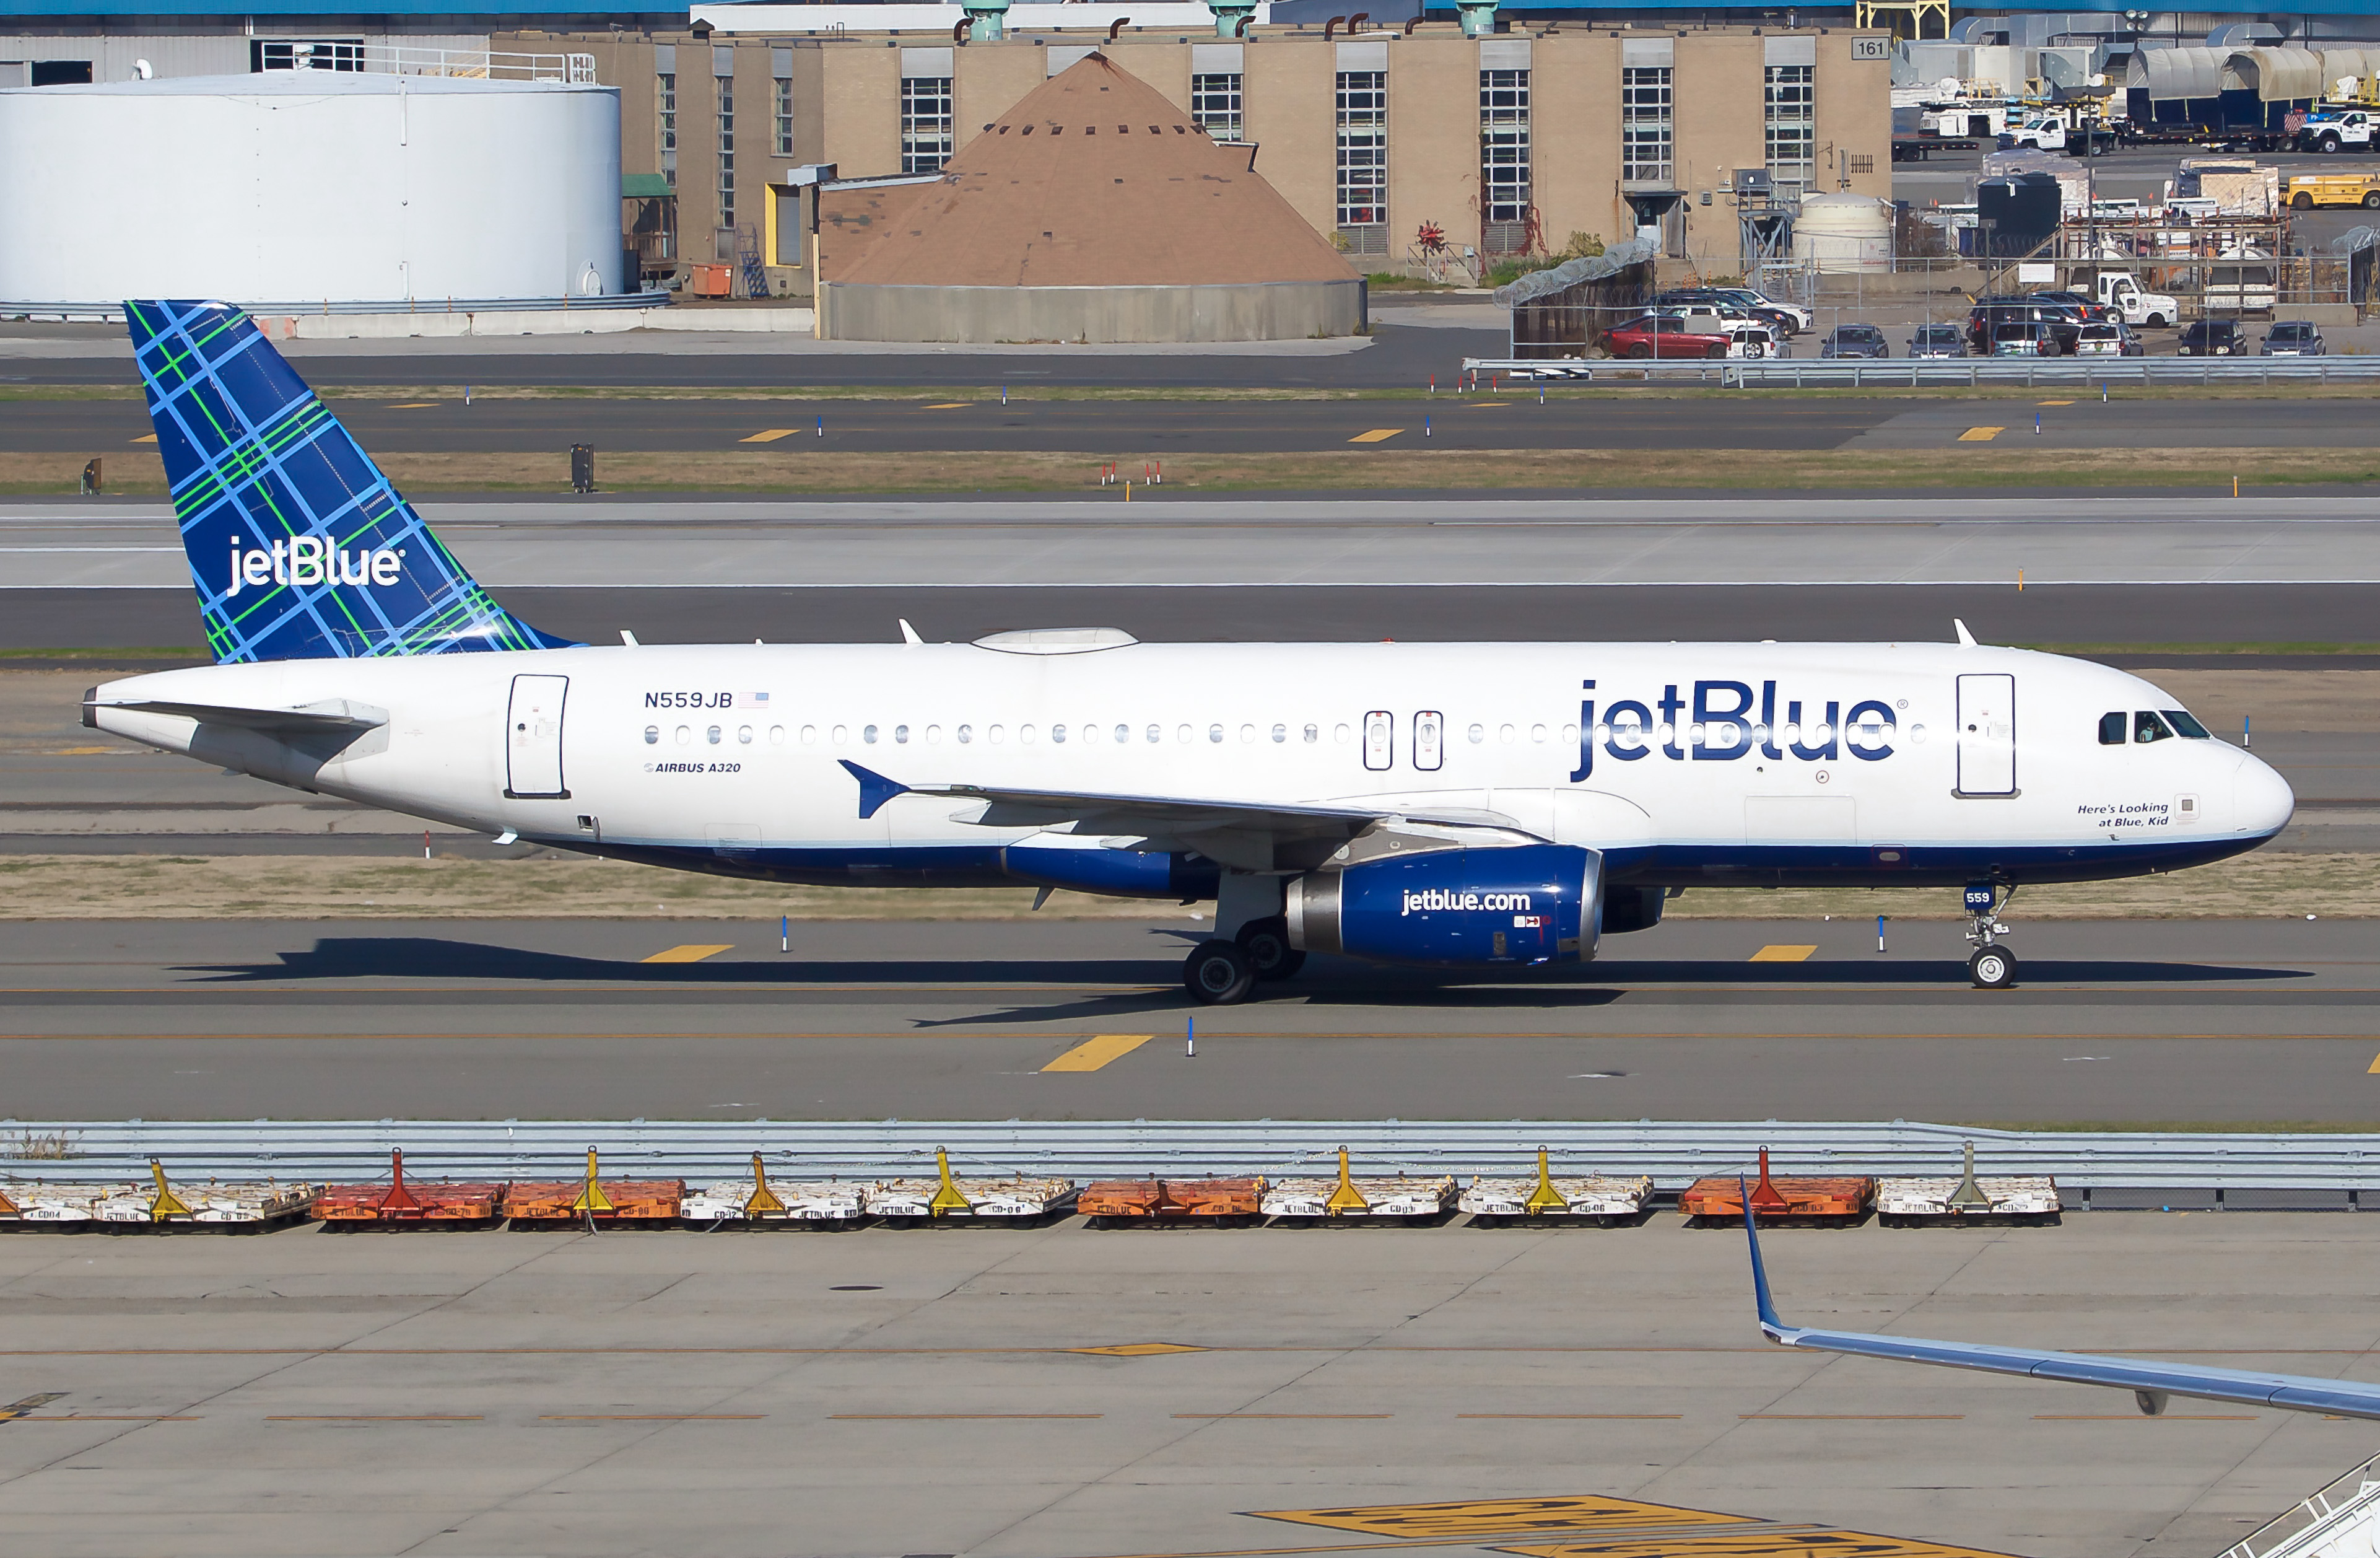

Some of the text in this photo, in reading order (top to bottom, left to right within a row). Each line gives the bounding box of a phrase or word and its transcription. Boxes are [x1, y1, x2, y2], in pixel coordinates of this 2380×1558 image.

[1859, 42, 1883, 55] 161
[645, 692, 733, 708] N559JB
[655, 763, 741, 772] AIRBUS A320
[2078, 802, 2168, 814] Here's Looking
[2099, 818, 2112, 827] at
[2114, 817, 2144, 828] Blue,
[2148, 816, 2169, 826] Kid
[1402, 889, 1530, 916] jetblue.com
[1966, 893, 1989, 903] 559
[879, 1206, 915, 1214] JETBLUE
